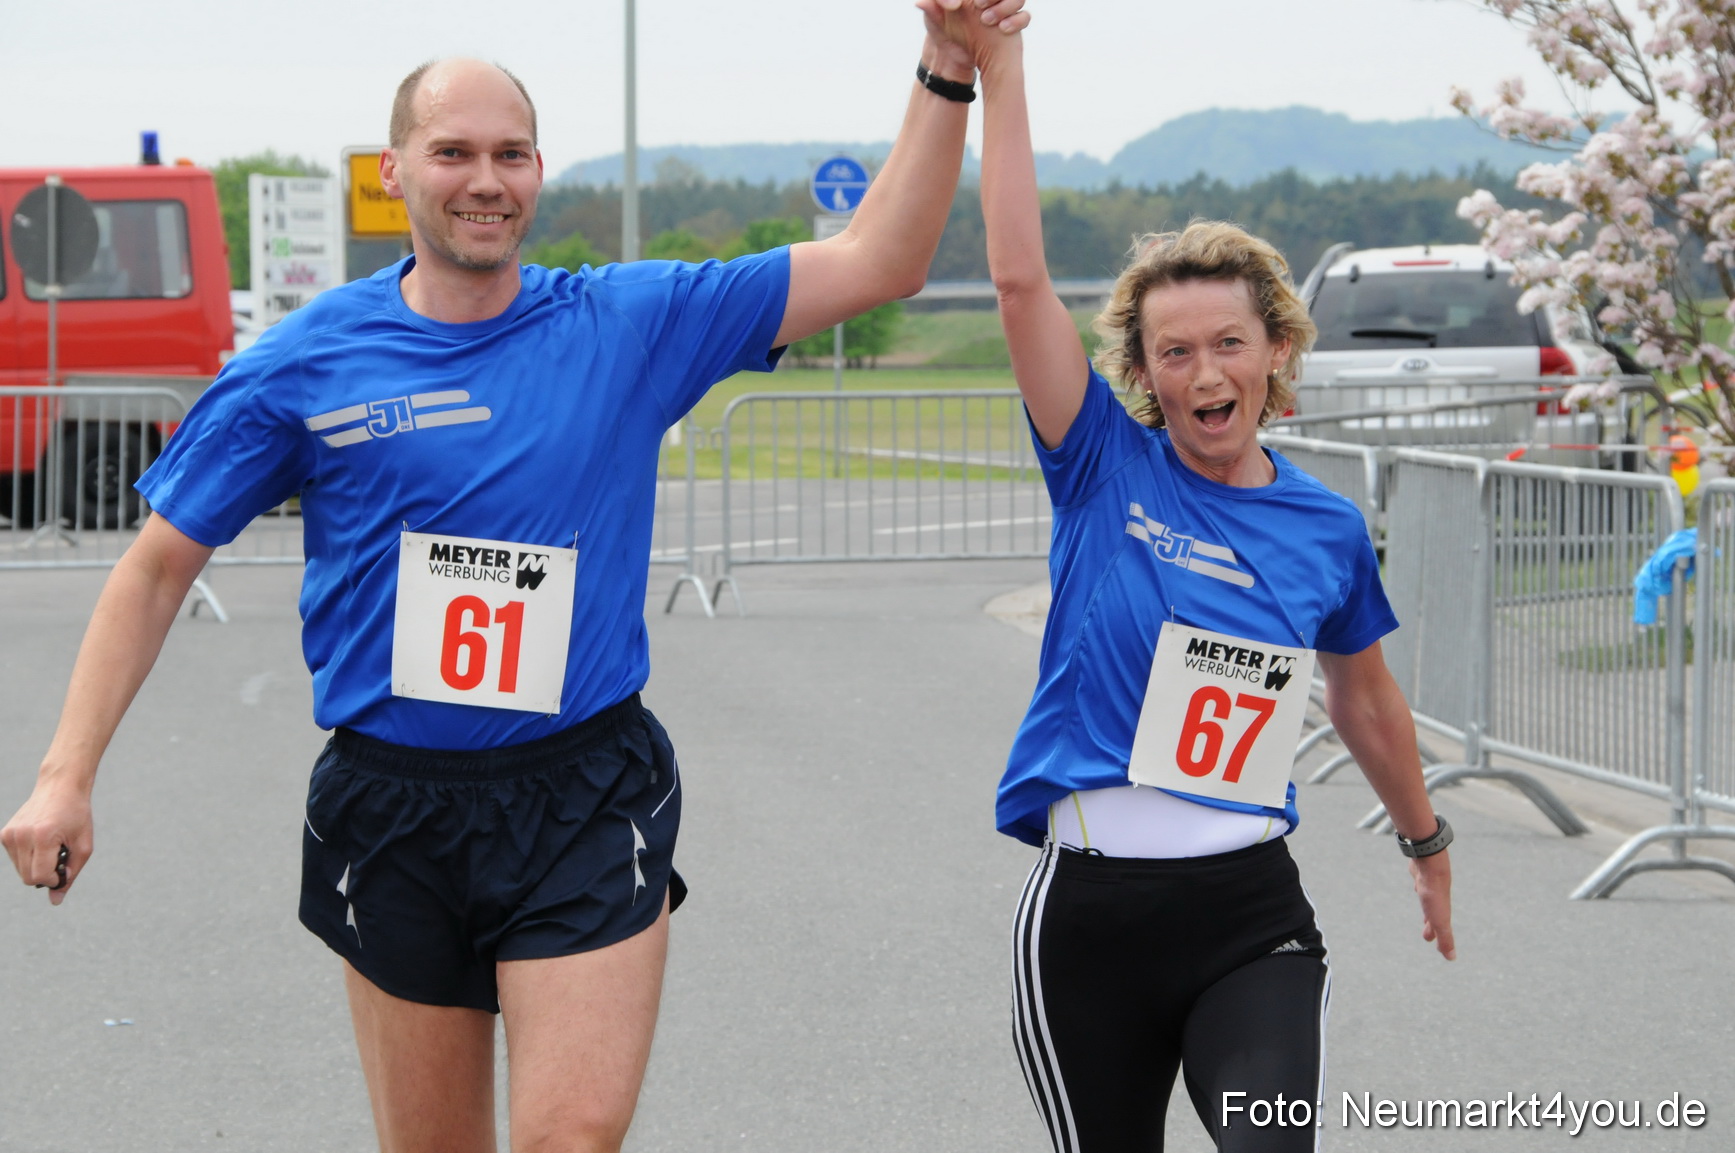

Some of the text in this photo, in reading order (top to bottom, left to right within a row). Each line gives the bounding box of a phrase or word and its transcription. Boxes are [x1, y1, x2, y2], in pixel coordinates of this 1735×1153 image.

[429, 543, 512, 568] MEYER
[429, 563, 510, 583] WERBUNG
[440, 595, 525, 693] 61
[1186, 638, 1265, 669] MEYER
[1184, 656, 1260, 683] WERBUNG
[1175, 686, 1277, 783] 67
